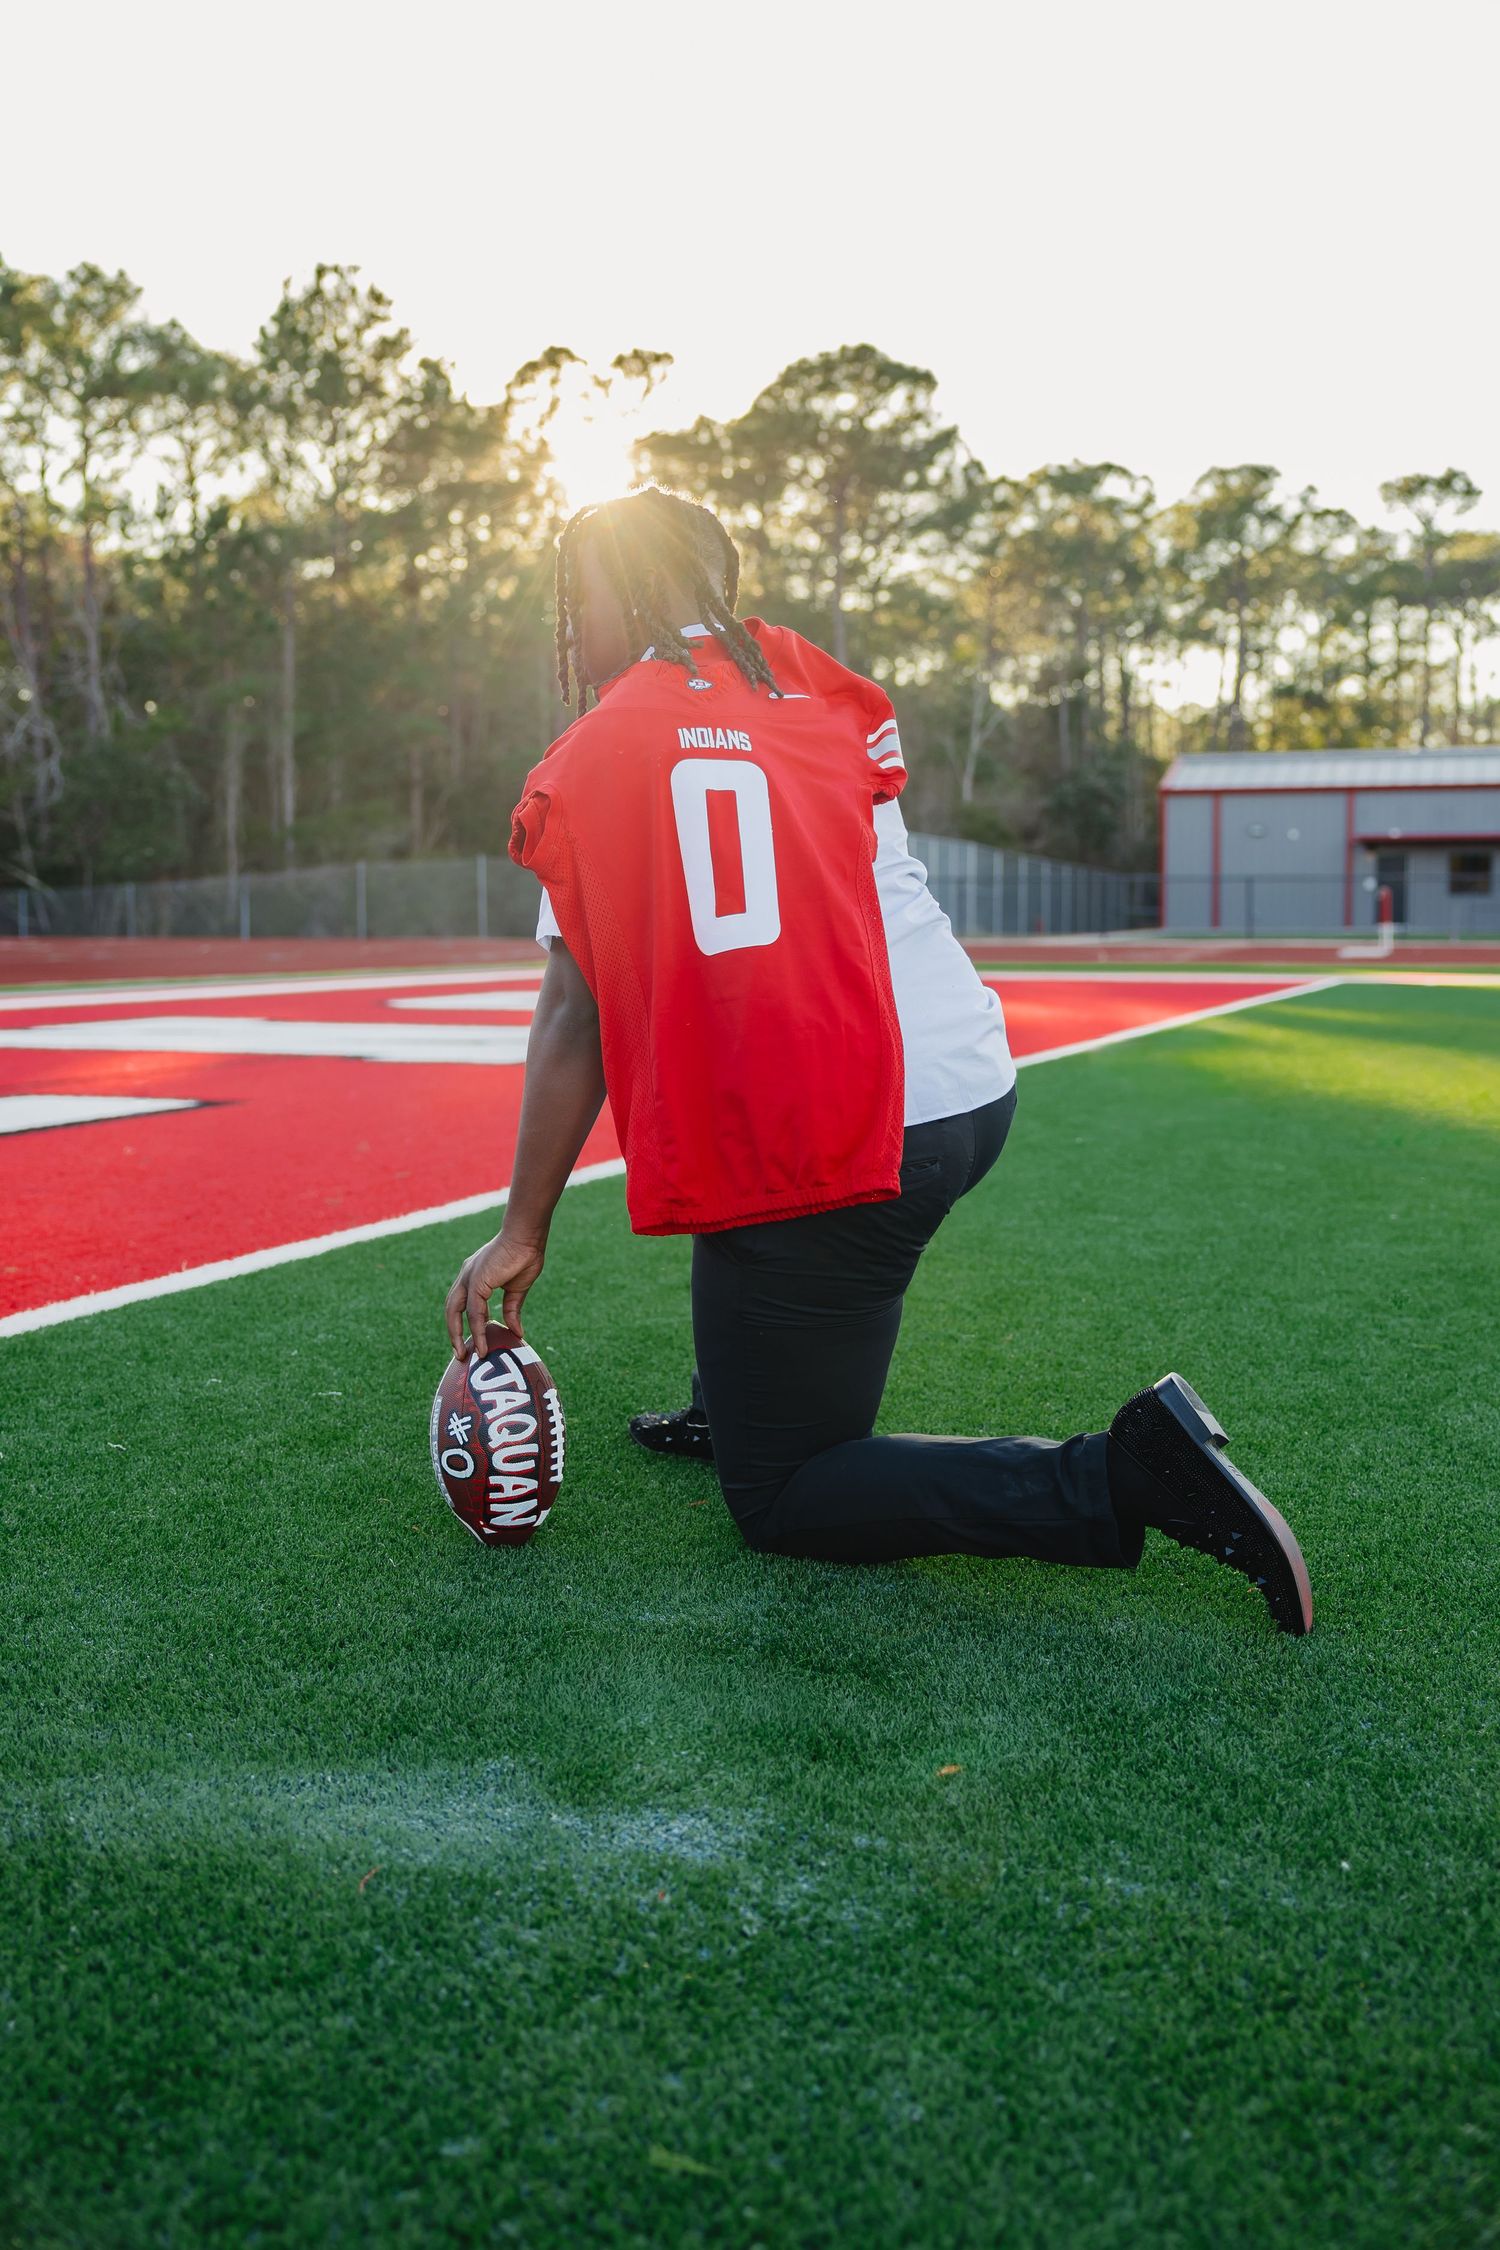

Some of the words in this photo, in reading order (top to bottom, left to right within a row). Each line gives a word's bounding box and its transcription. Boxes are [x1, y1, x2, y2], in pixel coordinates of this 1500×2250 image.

[677, 727, 752, 751] INDIANS
[670, 758, 781, 956] 0
[470, 1352, 539, 1526] JAQUAN
